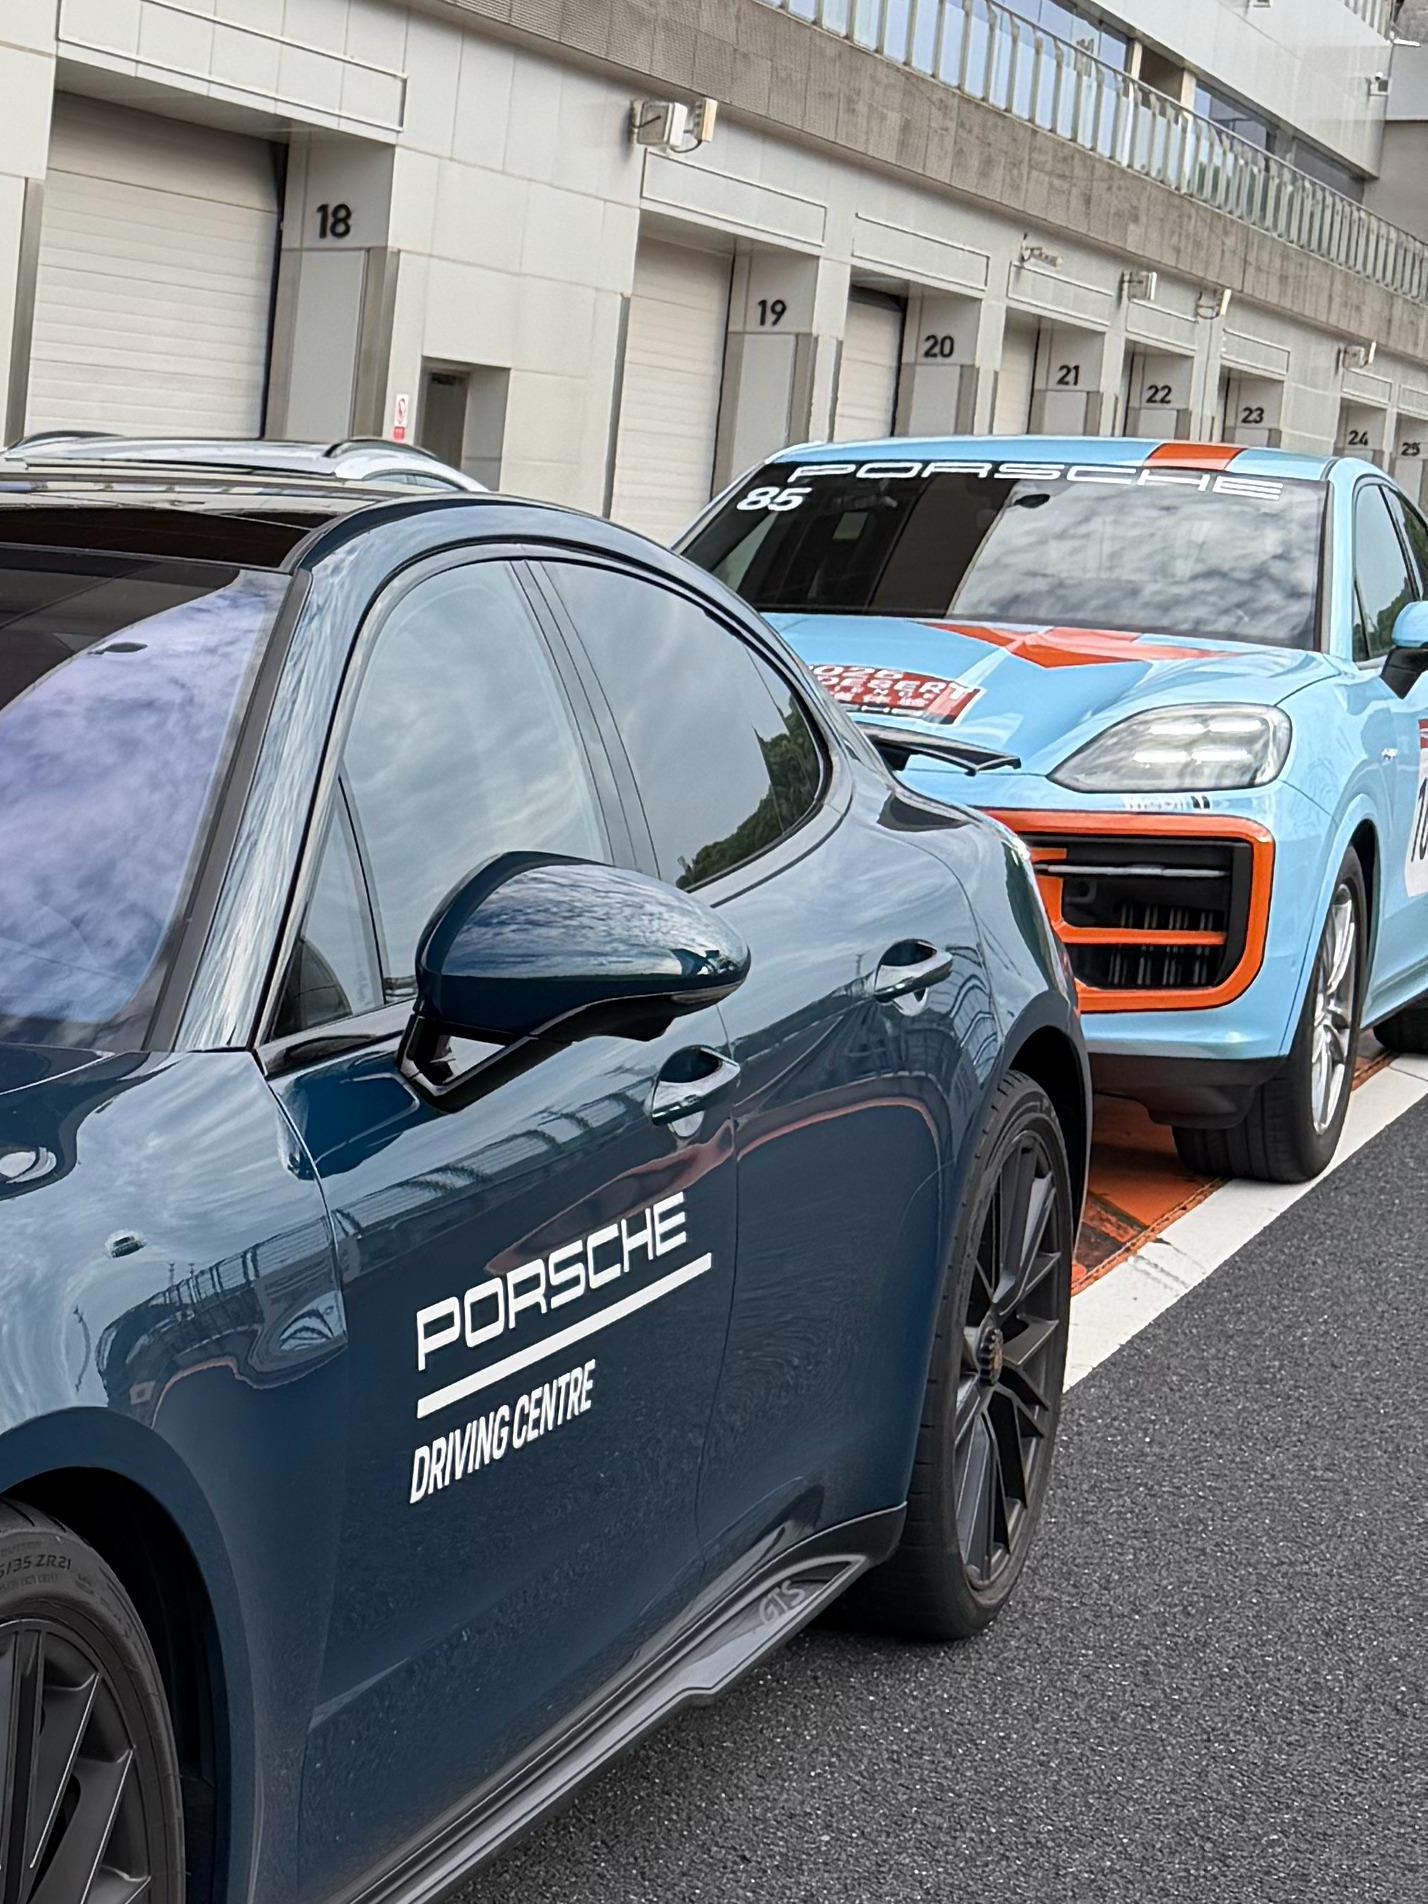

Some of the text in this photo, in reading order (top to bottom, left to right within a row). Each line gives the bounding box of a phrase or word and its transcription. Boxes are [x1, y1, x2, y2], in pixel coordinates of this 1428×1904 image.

[316, 203, 352, 239] 18
[757, 299, 787, 326] 19
[923, 334, 954, 358] 20
[1057, 364, 1080, 386] 21
[1145, 384, 1172, 404] 22
[1241, 407, 1265, 424] 23
[1348, 429, 1368, 446] 24
[787, 461, 1284, 500] PORSCHE
[736, 486, 813, 511] 85
[416, 1192, 687, 1371] PORSCHE
[410, 1359, 596, 1504] DRIVING CENTRE
